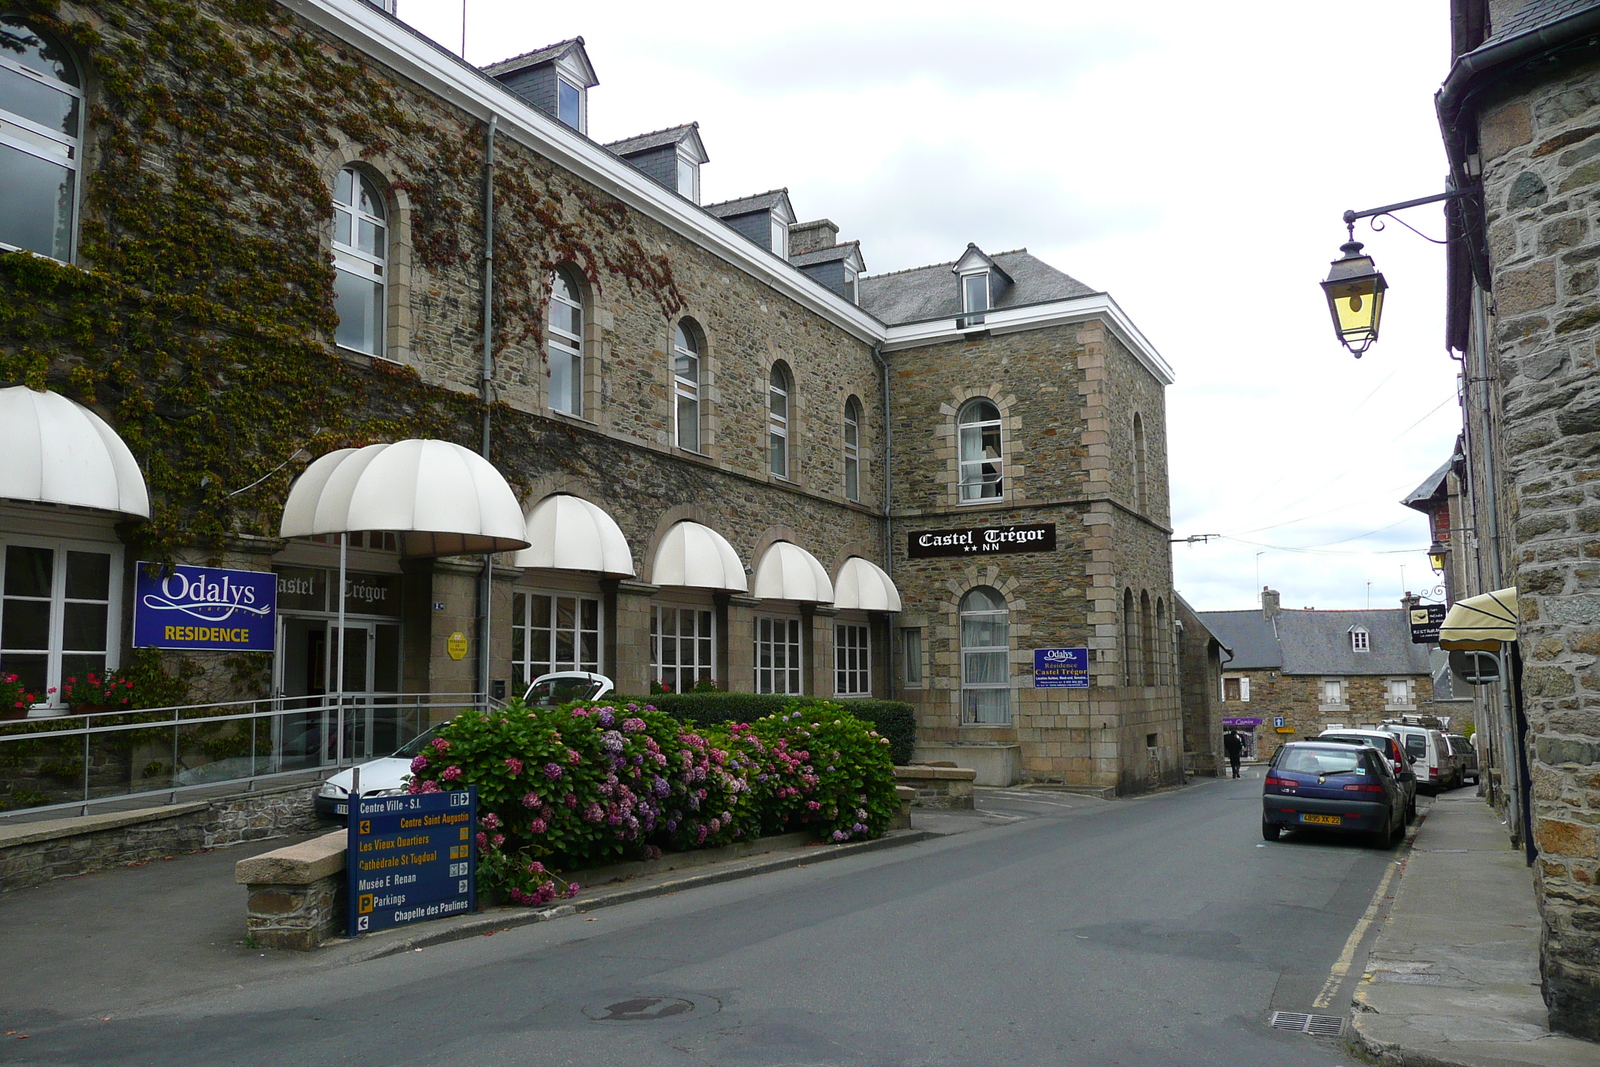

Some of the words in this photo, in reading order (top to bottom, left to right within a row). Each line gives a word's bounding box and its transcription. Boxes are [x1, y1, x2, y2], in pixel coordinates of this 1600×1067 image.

[918, 530, 973, 547] Castel
[983, 526, 1046, 544] Trégor
[162, 572, 255, 606] Odalys
[276, 576, 314, 595] astel
[165, 625, 250, 642] RESIDENCE
[1047, 650, 1073, 661] Odalys
[360, 801, 384, 814] Centre
[386, 799, 403, 811] Ville
[400, 817, 422, 829] Centre
[423, 812, 440, 826] Saint
[442, 811, 469, 825] Augustin
[359, 841, 372, 852] Les
[374, 838, 395, 850] Vieux
[397, 834, 429, 849] Quartiers
[359, 856, 399, 871] Cathédrale
[401, 854, 408, 865] St
[358, 876, 384, 891] Musée
[394, 874, 416, 886] Renan
[373, 894, 406, 908] Parkings
[394, 907, 425, 921] Chapelle
[426, 904, 438, 915] des
[440, 900, 468, 913] Paulines
